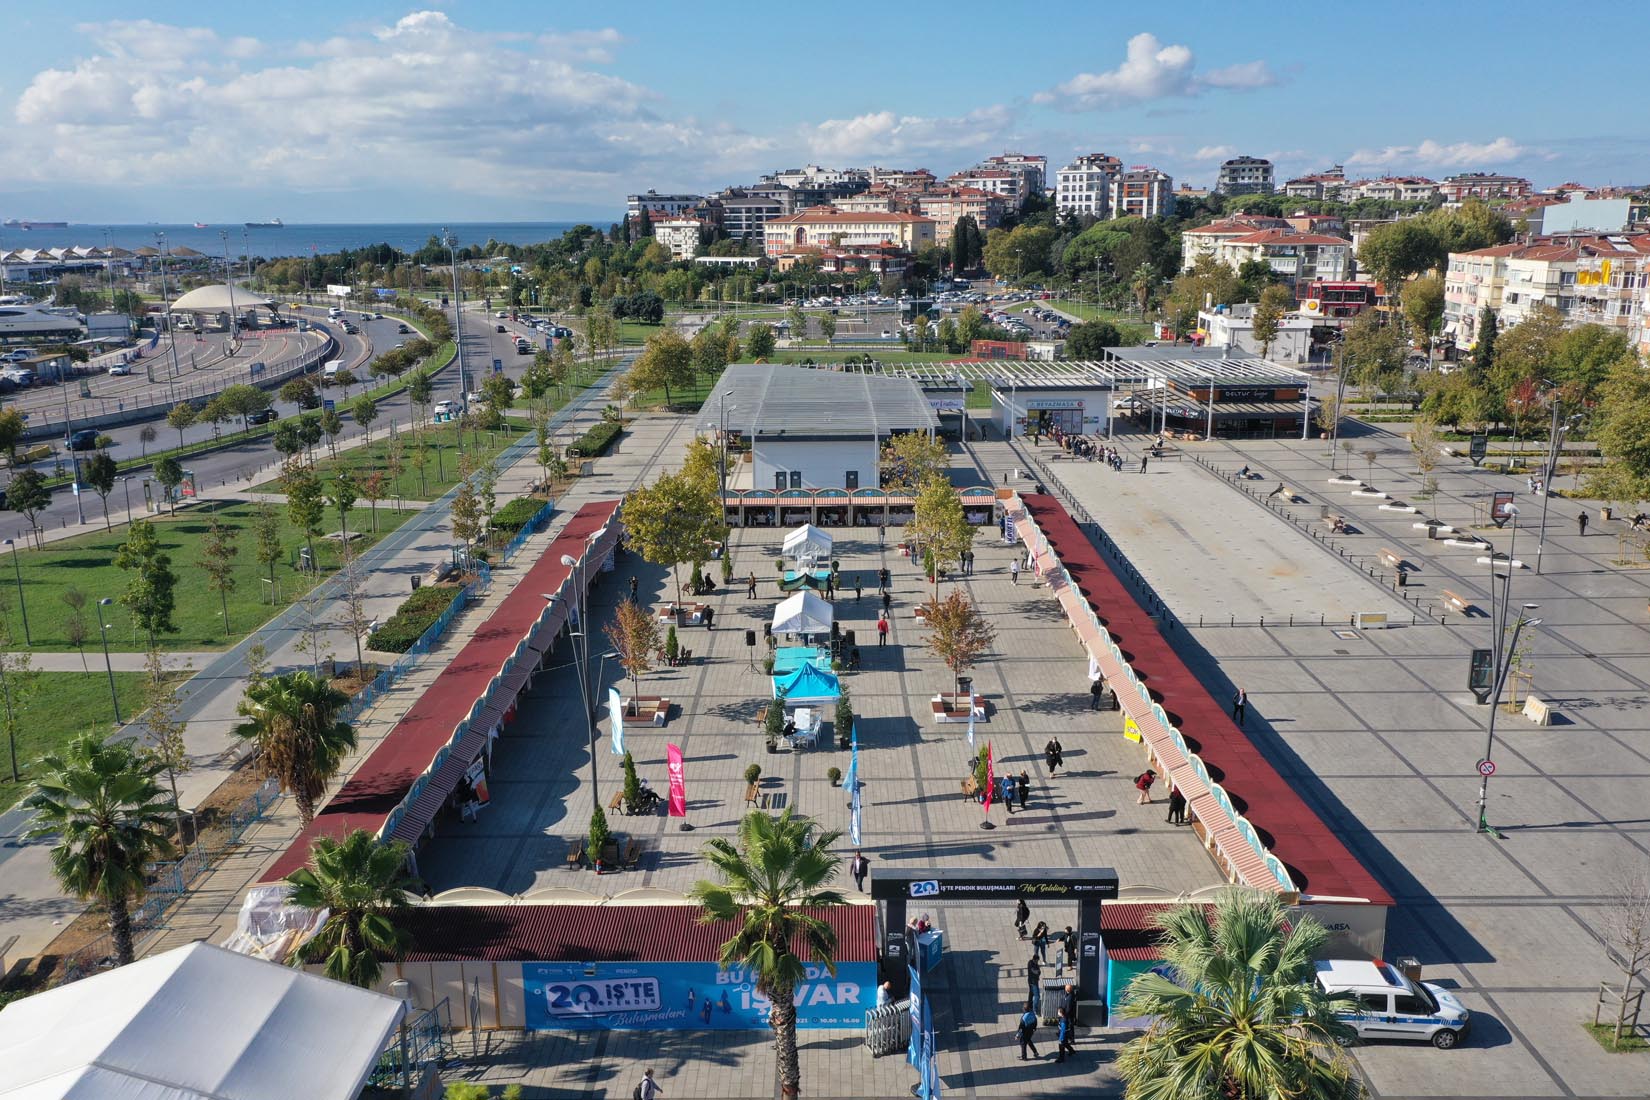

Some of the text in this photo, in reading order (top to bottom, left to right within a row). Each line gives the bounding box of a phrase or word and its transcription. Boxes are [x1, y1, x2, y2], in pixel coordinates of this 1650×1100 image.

[716, 969, 744, 984] BU
[792, 982, 860, 1007] VAR
[609, 1008, 688, 1027] Buluşmaları
